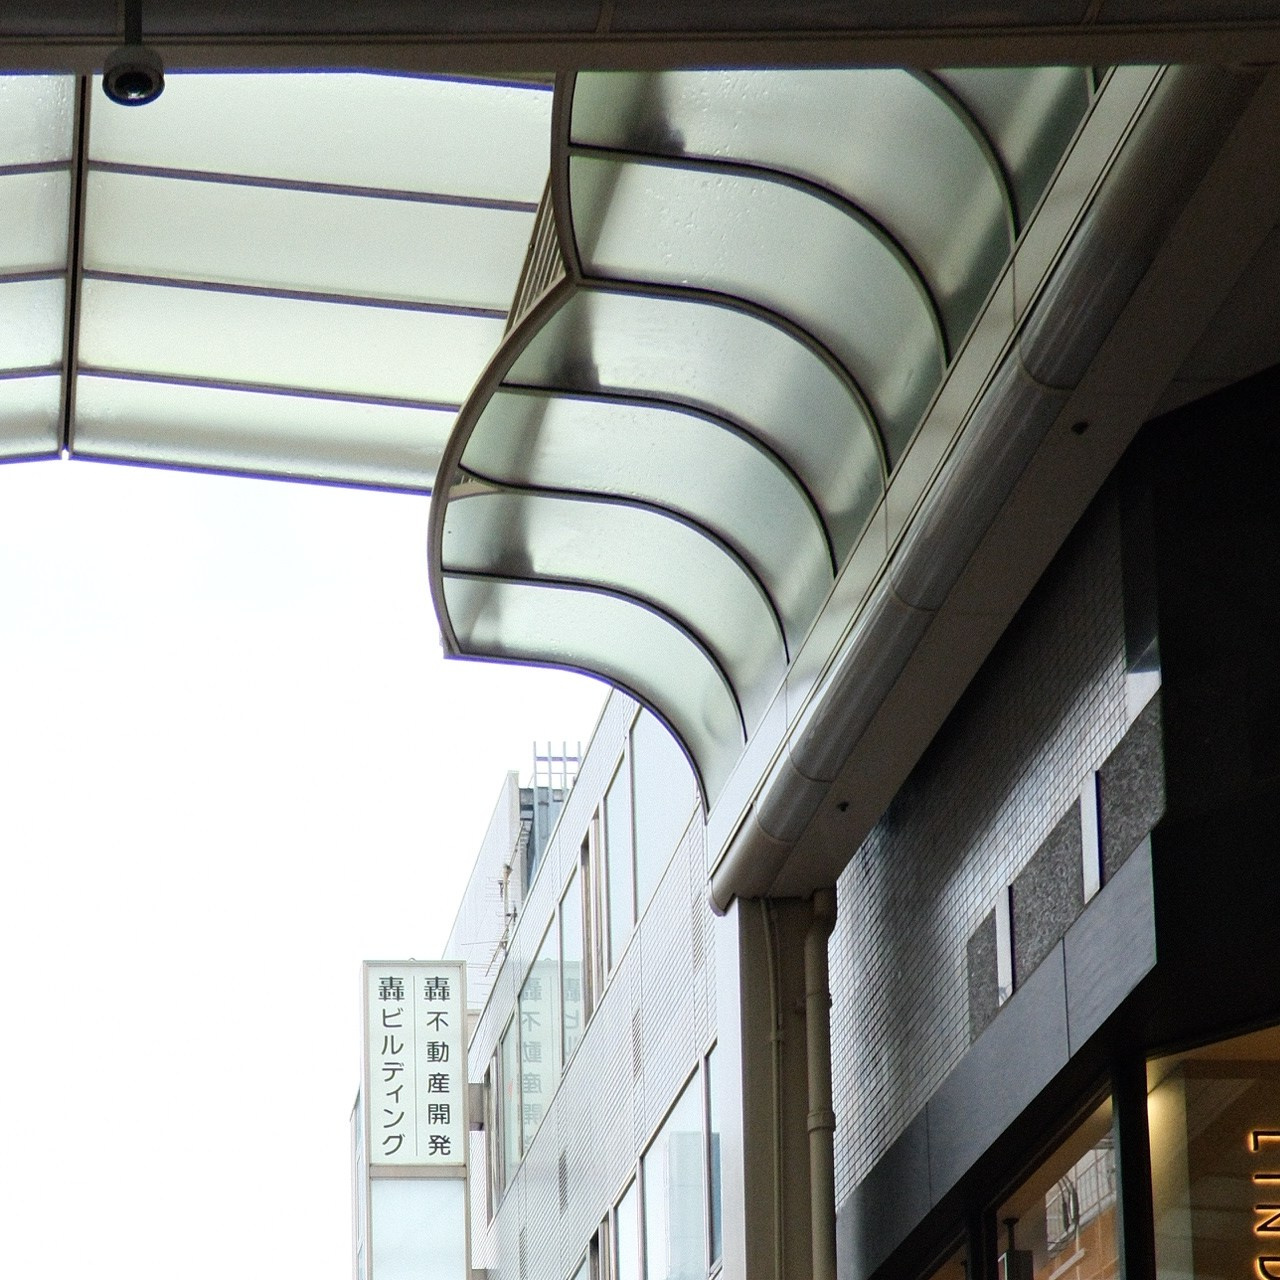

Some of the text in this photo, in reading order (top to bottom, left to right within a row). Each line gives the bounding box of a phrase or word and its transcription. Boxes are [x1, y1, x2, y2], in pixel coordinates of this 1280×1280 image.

[378, 976, 405, 1156] 轟ビルディング
[424, 976, 451, 1156] 轟不動産開発
